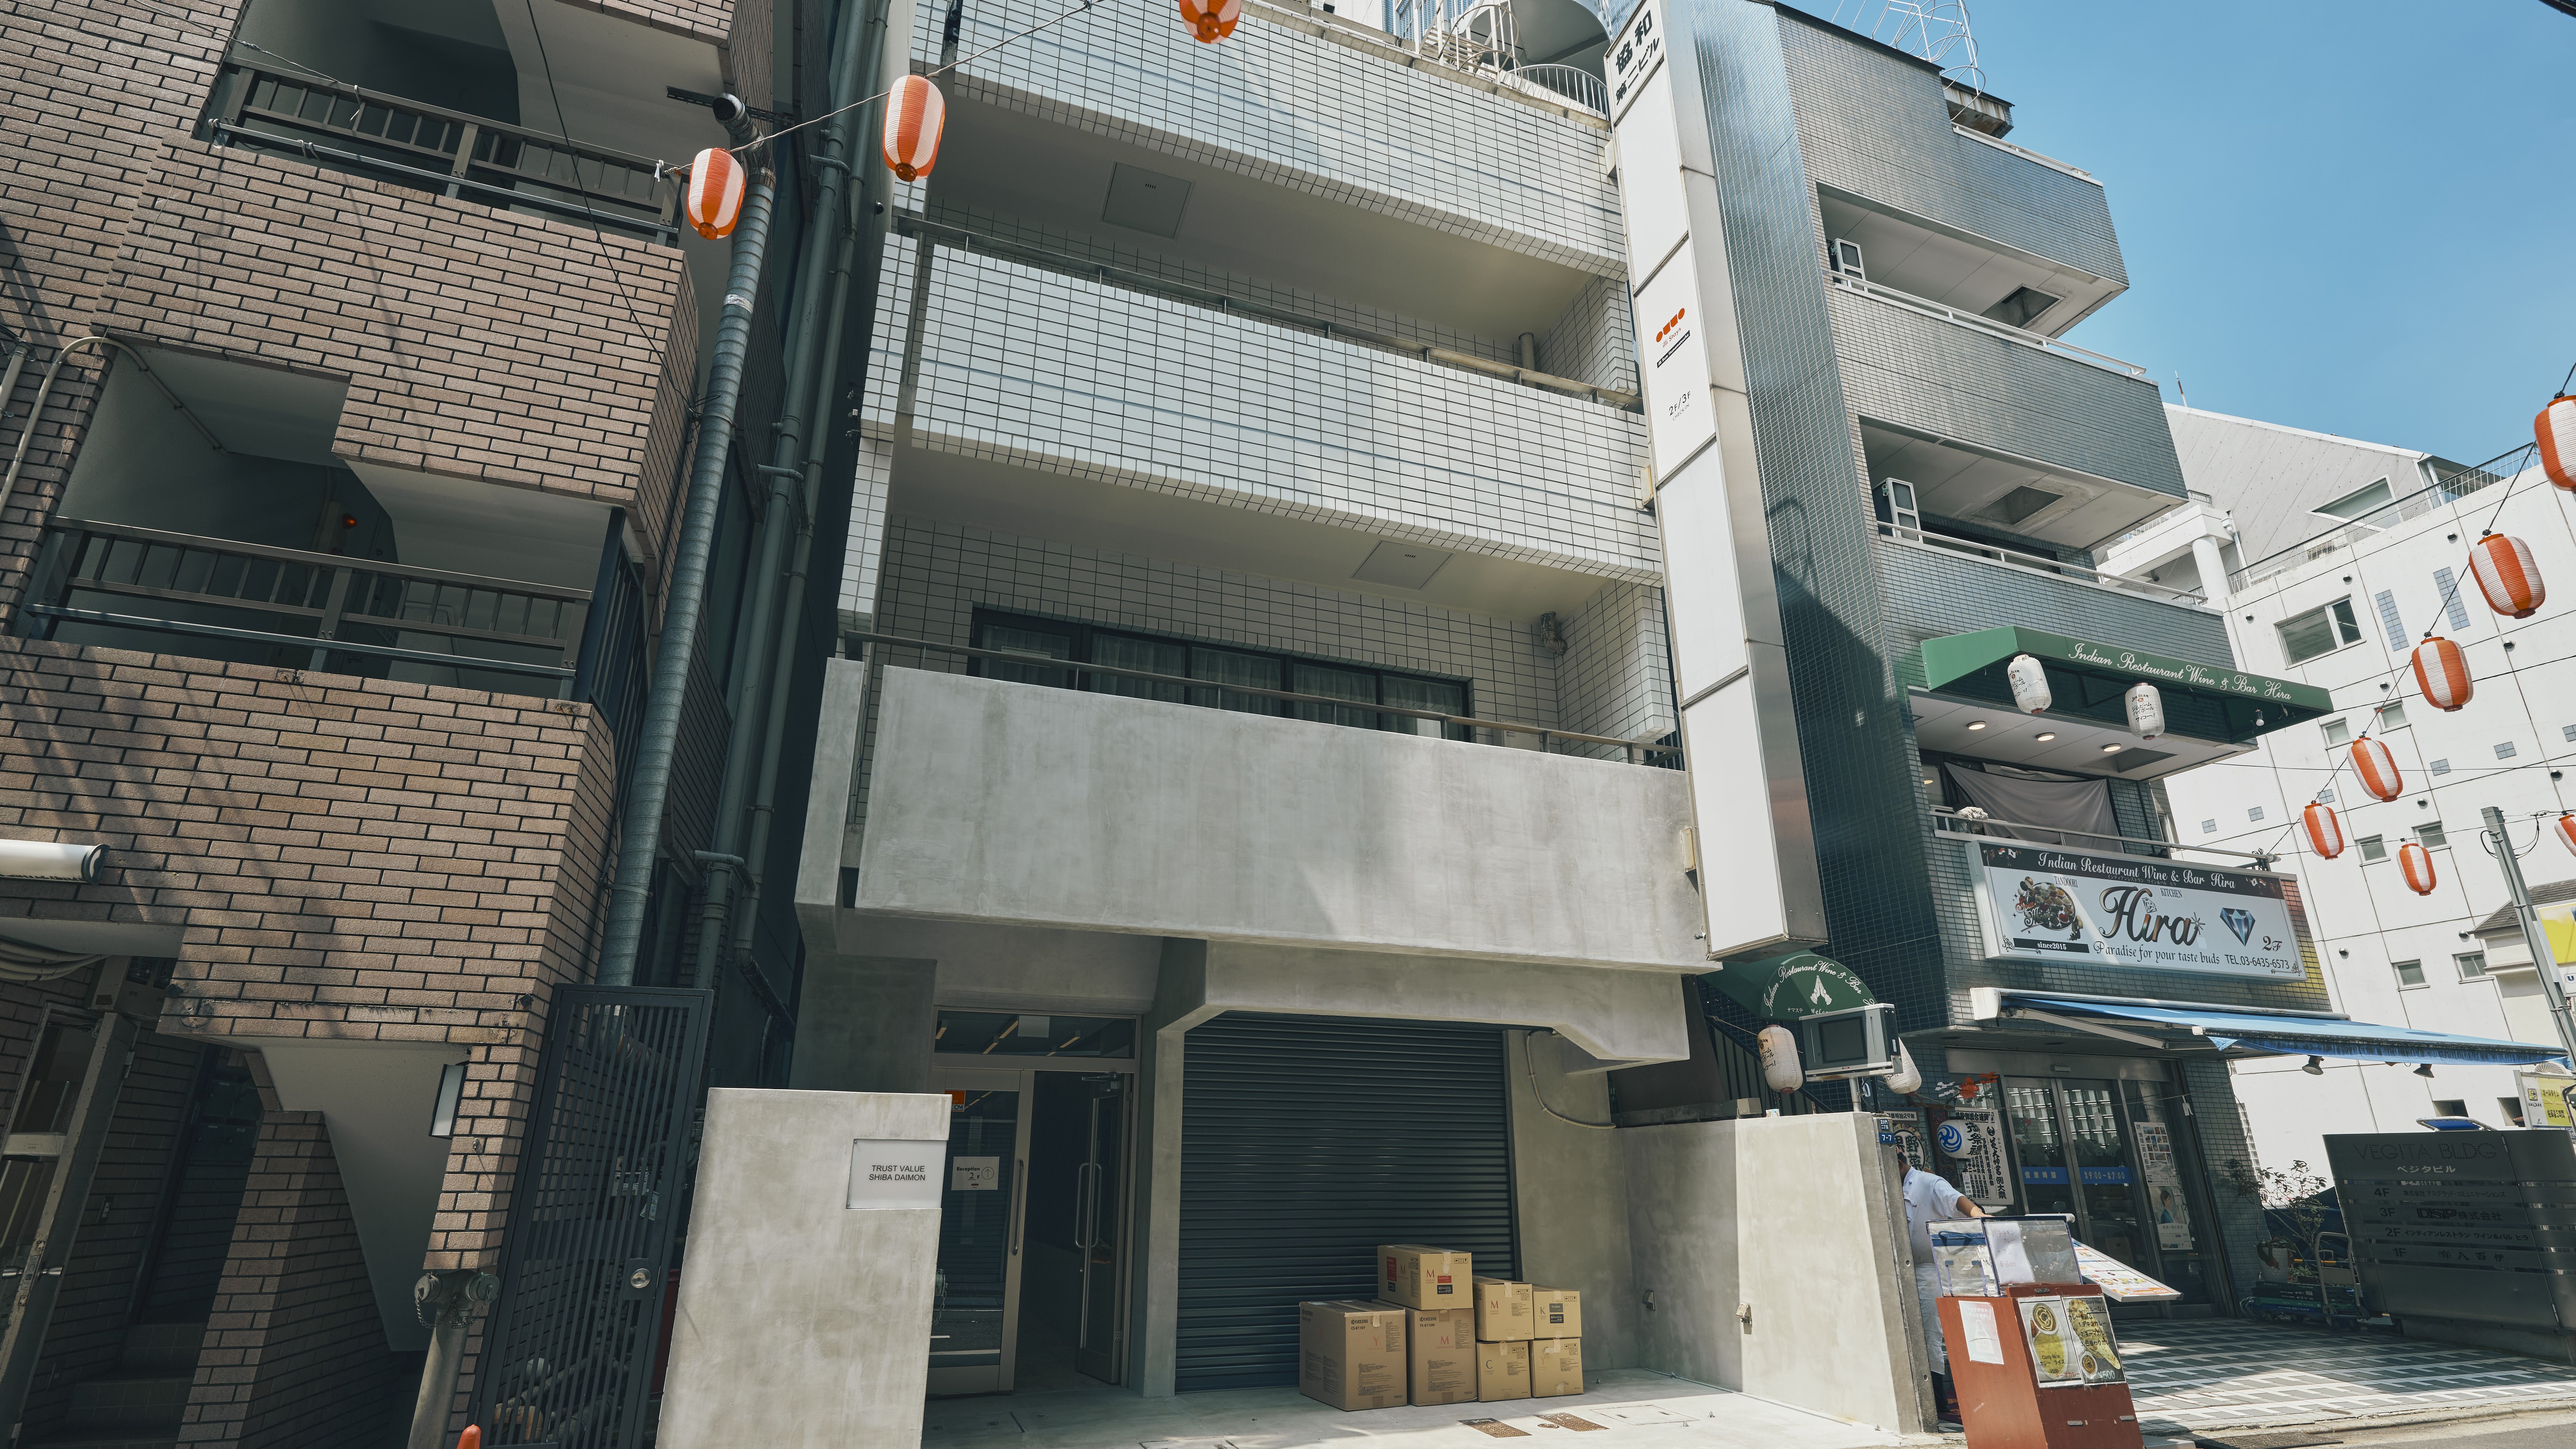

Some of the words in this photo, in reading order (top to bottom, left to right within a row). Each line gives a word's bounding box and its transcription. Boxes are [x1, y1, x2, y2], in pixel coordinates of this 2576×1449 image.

[1616, 9, 1652, 75] 協和
[1616, 37, 1659, 105] 第二ビル
[1669, 327, 1681, 341] Stays
[1668, 333, 1689, 356] Hamamatsucho
[1669, 391, 1691, 416] 2F/3F
[2068, 643, 2112, 665] Indian
[2117, 652, 2184, 679] Restaurant
[2186, 665, 2215, 685] Wine
[2220, 678, 2229, 690] &
[2232, 675, 2257, 694] Bar
[2264, 680, 2291, 700] Hira
[2132, 702, 2152, 712] ジムビーム
[2133, 706, 2154, 716] ハイボール
[2038, 852, 2078, 871] Indian
[2081, 857, 2140, 878] Restaurant
[2142, 865, 2168, 881] Wine
[2171, 870, 2180, 881] &
[2183, 869, 2205, 885] Bar
[2211, 872, 2236, 889] Hira
[2054, 876, 2078, 888] TANDOORI
[2108, 875, 2144, 883] インディアンレストラン
[2160, 888, 2182, 898] KITCHEN
[2099, 886, 2199, 946] Hira
[2037, 941, 2066, 950] since2015
[2262, 936, 2282, 952] 2F
[2094, 941, 2137, 957] Paradise
[2137, 945, 2152, 962] for
[2155, 950, 2175, 963] your
[2178, 951, 2197, 963] taste
[2201, 952, 2220, 964] buds
[2225, 954, 2290, 969] TEL.03-6435-6573
[1764, 983, 1779, 1017] Indian
[1778, 964, 1818, 983] Restaurant
[1818, 960, 1837, 975] Wine
[1845, 976, 1862, 994] Bar
[2353, 1143, 2433, 1160] VEGITA
[2438, 1143, 2497, 1159] BLDG
[2397, 1165, 2456, 1173] ベジタビル
[2374, 1188, 2390, 1197] 4F
[2380, 1208, 2395, 1217] 3F
[2458, 1211, 2503, 1221] 株式会社
[2385, 1227, 2401, 1237] 2F
[2405, 1230, 2470, 1239] インディアンレストラン
[2393, 1248, 2406, 1258] 1F
[1999, 1260, 2017, 1268] ¥600
[1427, 1269, 1434, 1278] M
[1491, 1300, 1498, 1309] M
[1540, 1306, 1546, 1315] K
[1373, 1336, 1379, 1346] Y
[1441, 1335, 1449, 1345] M
[1486, 1360, 1493, 1369] C
[2098, 1370, 2115, 1379] ¥500
